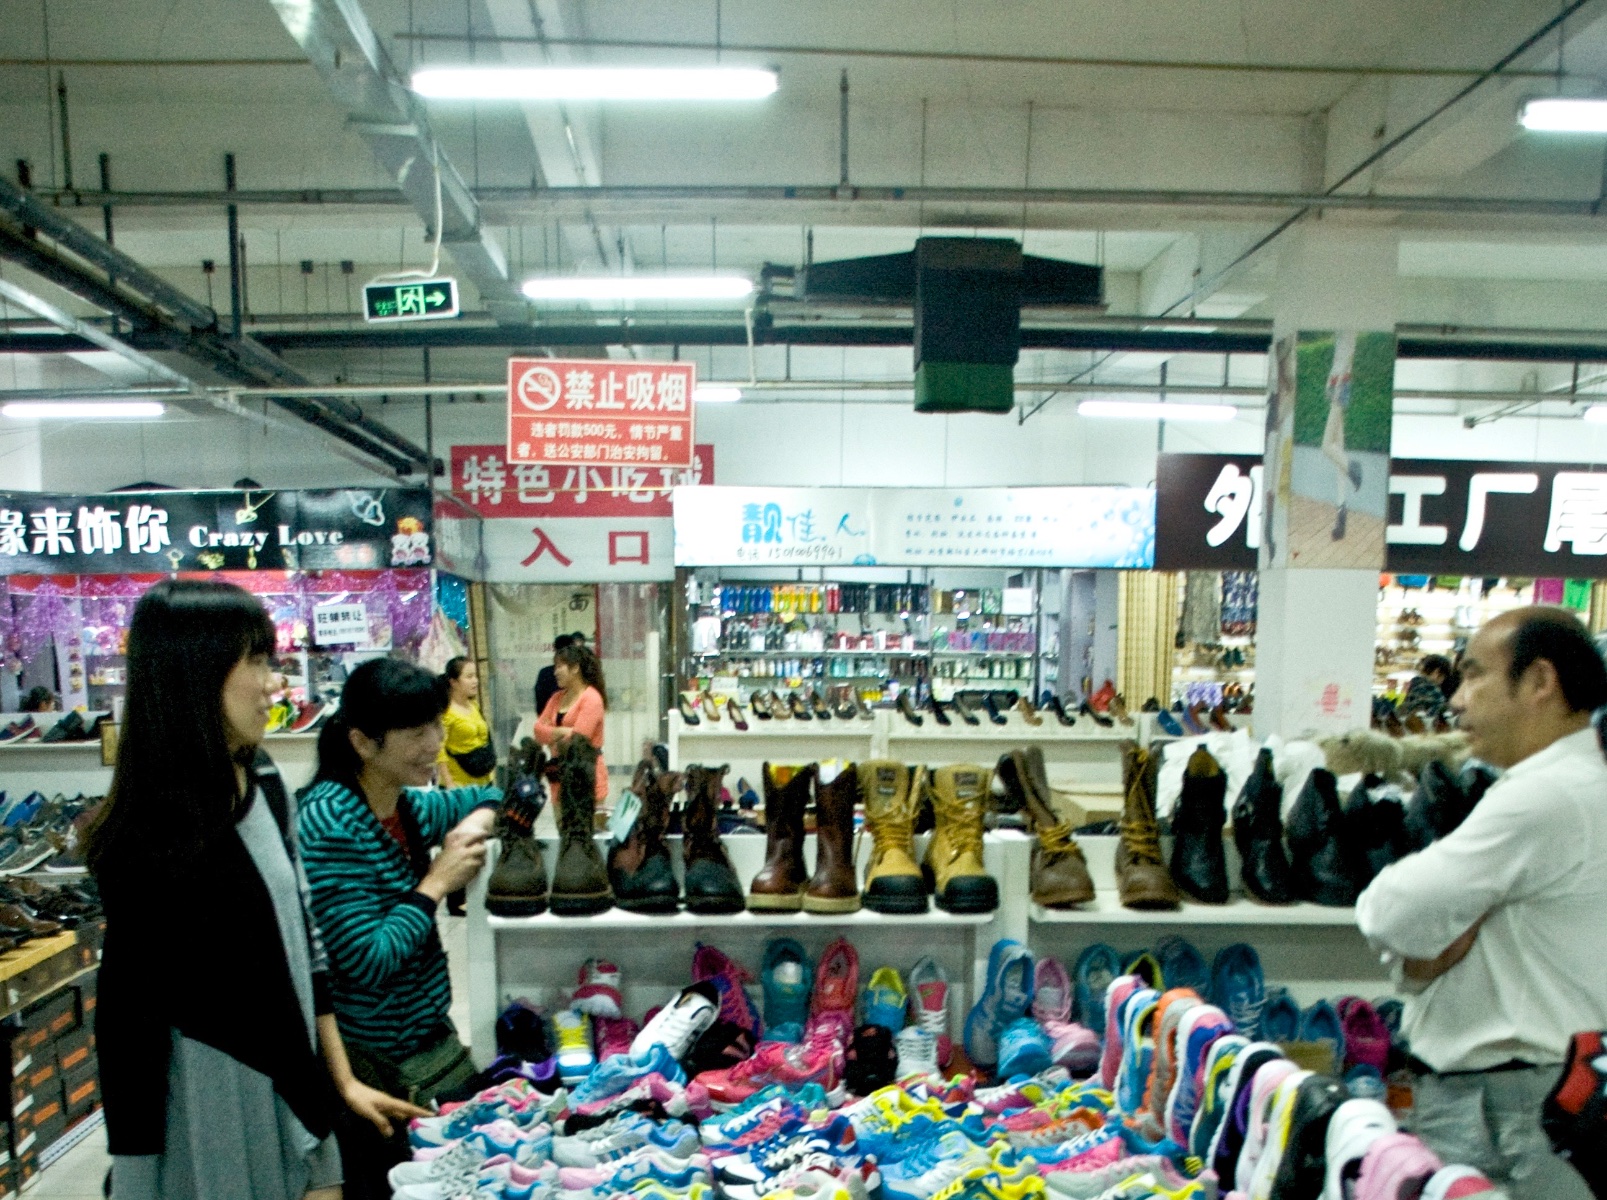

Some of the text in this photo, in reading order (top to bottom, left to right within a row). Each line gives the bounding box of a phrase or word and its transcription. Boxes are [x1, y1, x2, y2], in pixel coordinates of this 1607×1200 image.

[564, 370, 687, 412] 禁止吸烟
[189, 525, 344, 551] Crazy Love
[520, 526, 650, 567] 入口
